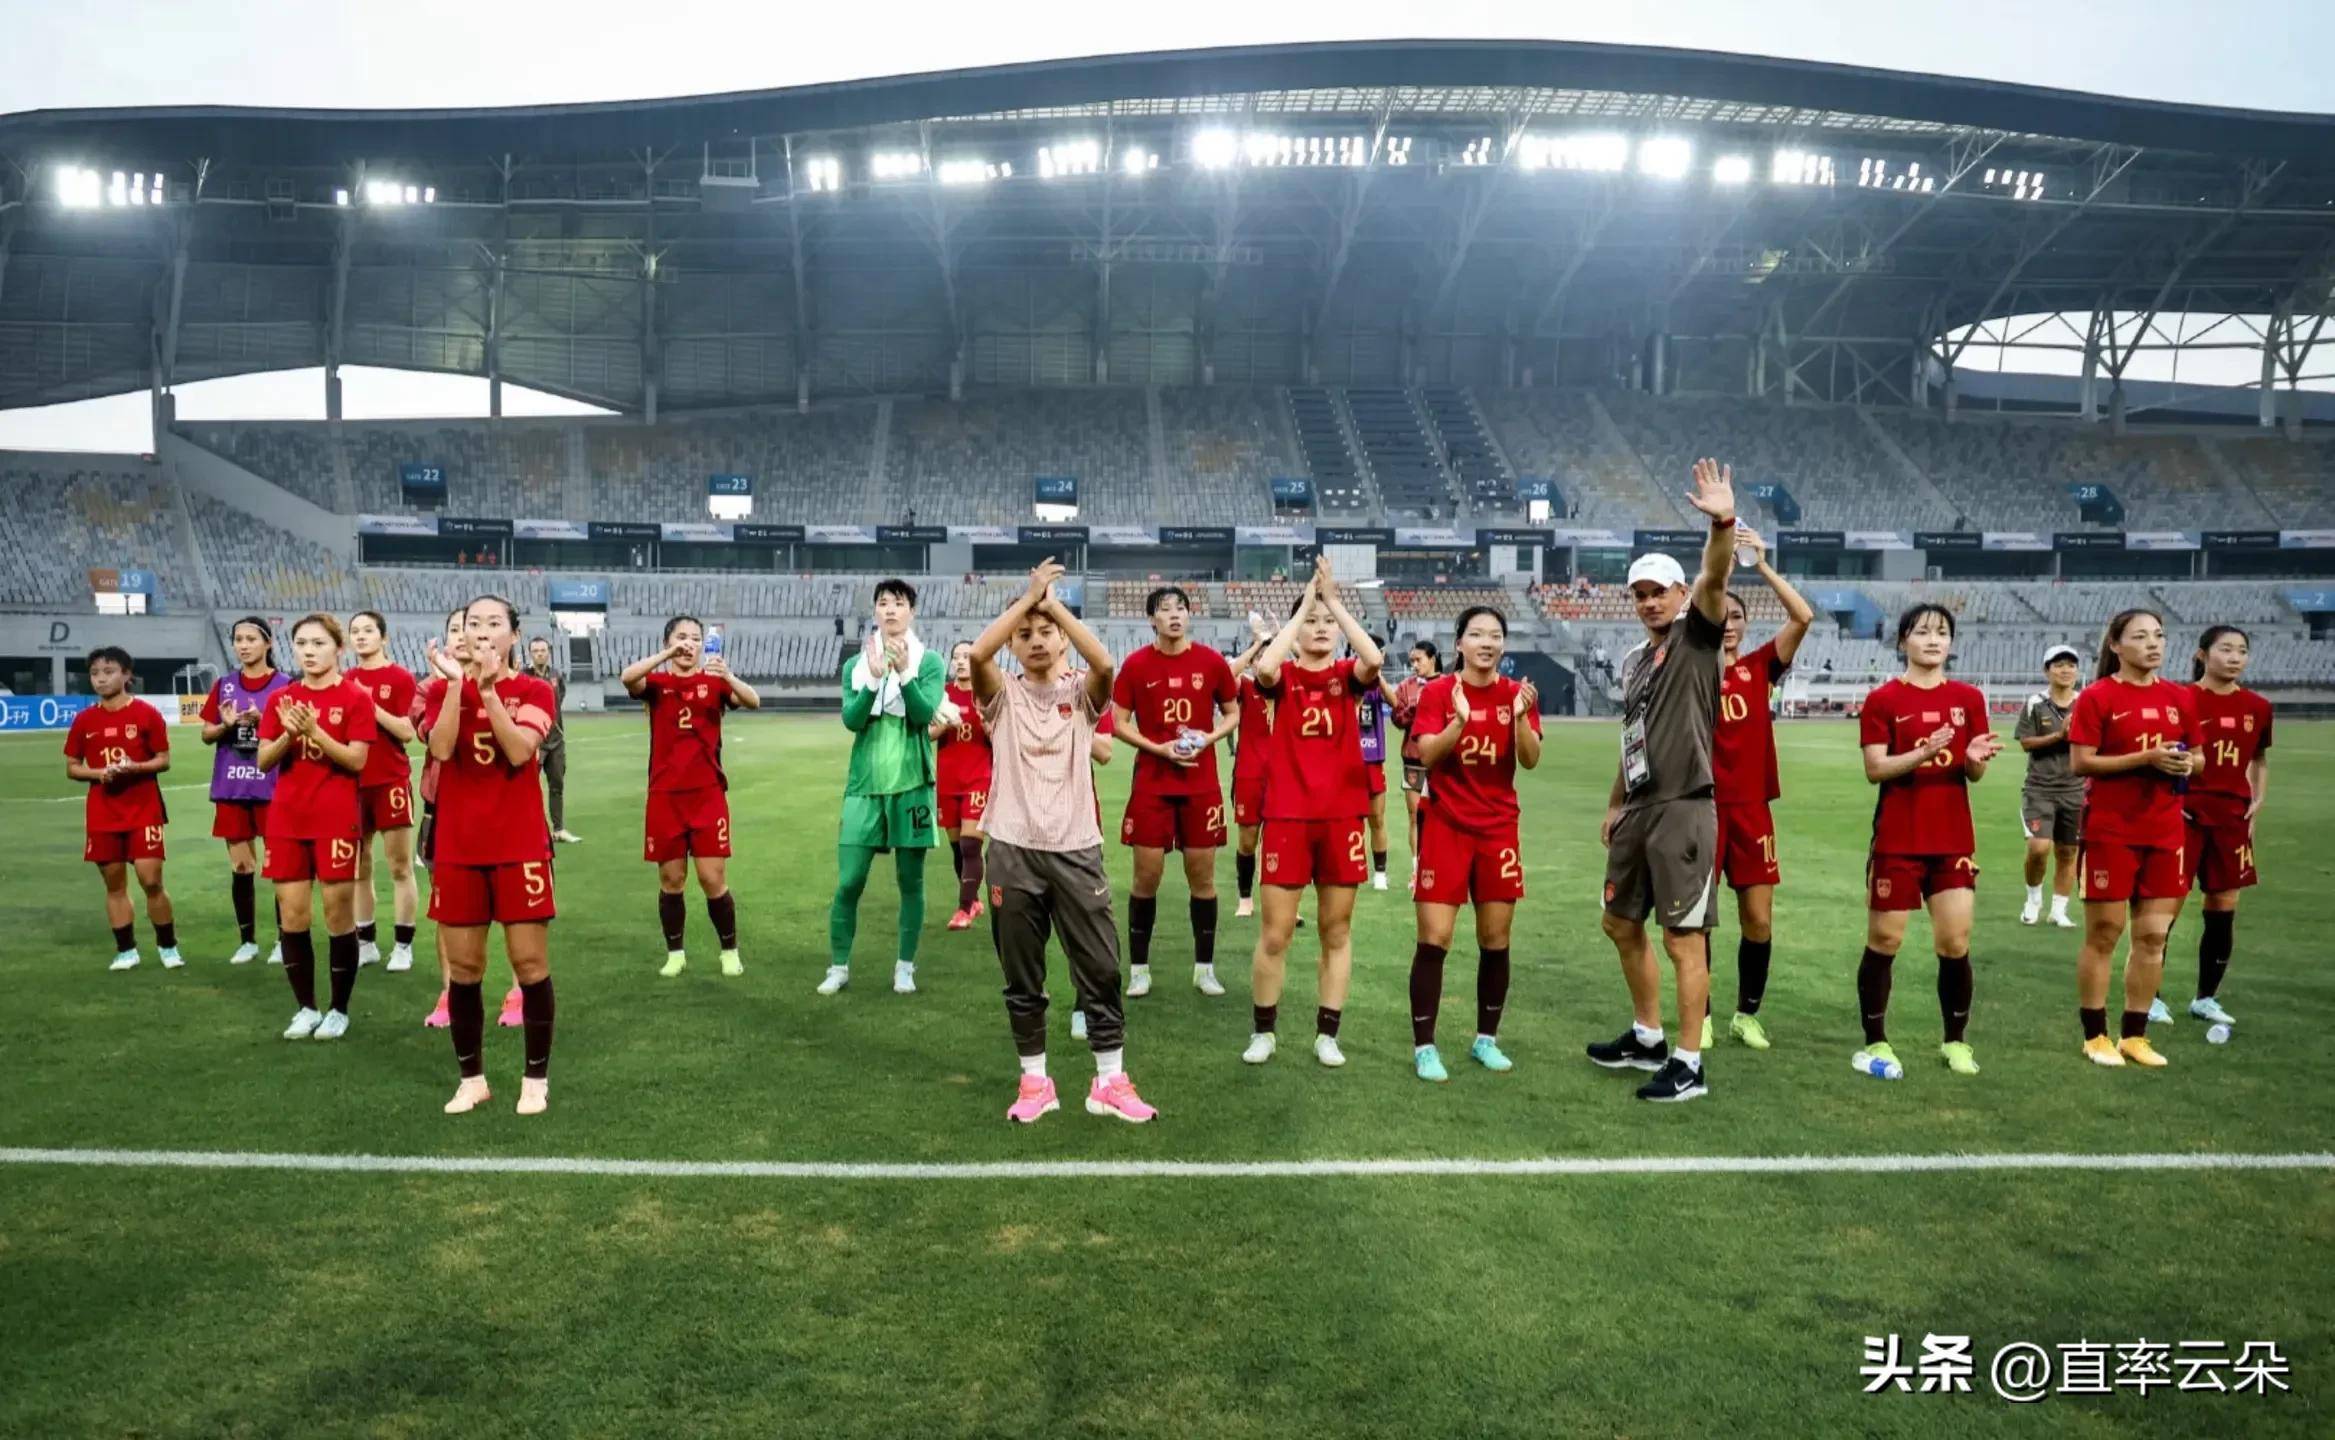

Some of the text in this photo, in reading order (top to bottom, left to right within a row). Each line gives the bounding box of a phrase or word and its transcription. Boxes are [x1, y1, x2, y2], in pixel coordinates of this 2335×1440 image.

[423, 468, 439, 481] 22
[731, 478, 748, 490] 23
[1058, 480, 1074, 493] 24
[1290, 481, 1306, 494] 25
[1532, 483, 1548, 496] 26
[1759, 485, 1775, 498] 27
[2080, 486, 2098, 499] 28
[120, 573, 142, 589] 19
[579, 583, 598, 598] 20
[50, 621, 70, 642] D
[678, 706, 693, 728] 2
[1163, 698, 1192, 722] 20
[1720, 693, 1748, 722] 10
[956, 722, 973, 742] 18
[1302, 706, 1333, 736] 21
[473, 731, 495, 765] 5
[1461, 735, 1497, 765] 24
[2135, 732, 2162, 753] 11
[2213, 739, 2239, 767] 14
[100, 747, 127, 767] 19
[227, 765, 266, 781] 2025
[389, 787, 406, 810] 6
[968, 791, 987, 809] 18
[905, 804, 931, 830] 12
[716, 817, 728, 841] 2
[332, 838, 354, 860] 15
[1347, 830, 1364, 862] 2
[1499, 847, 1518, 879] 2
[2175, 845, 2185, 876] 1
[2235, 844, 2254, 871] 14
[523, 860, 545, 895] 5
